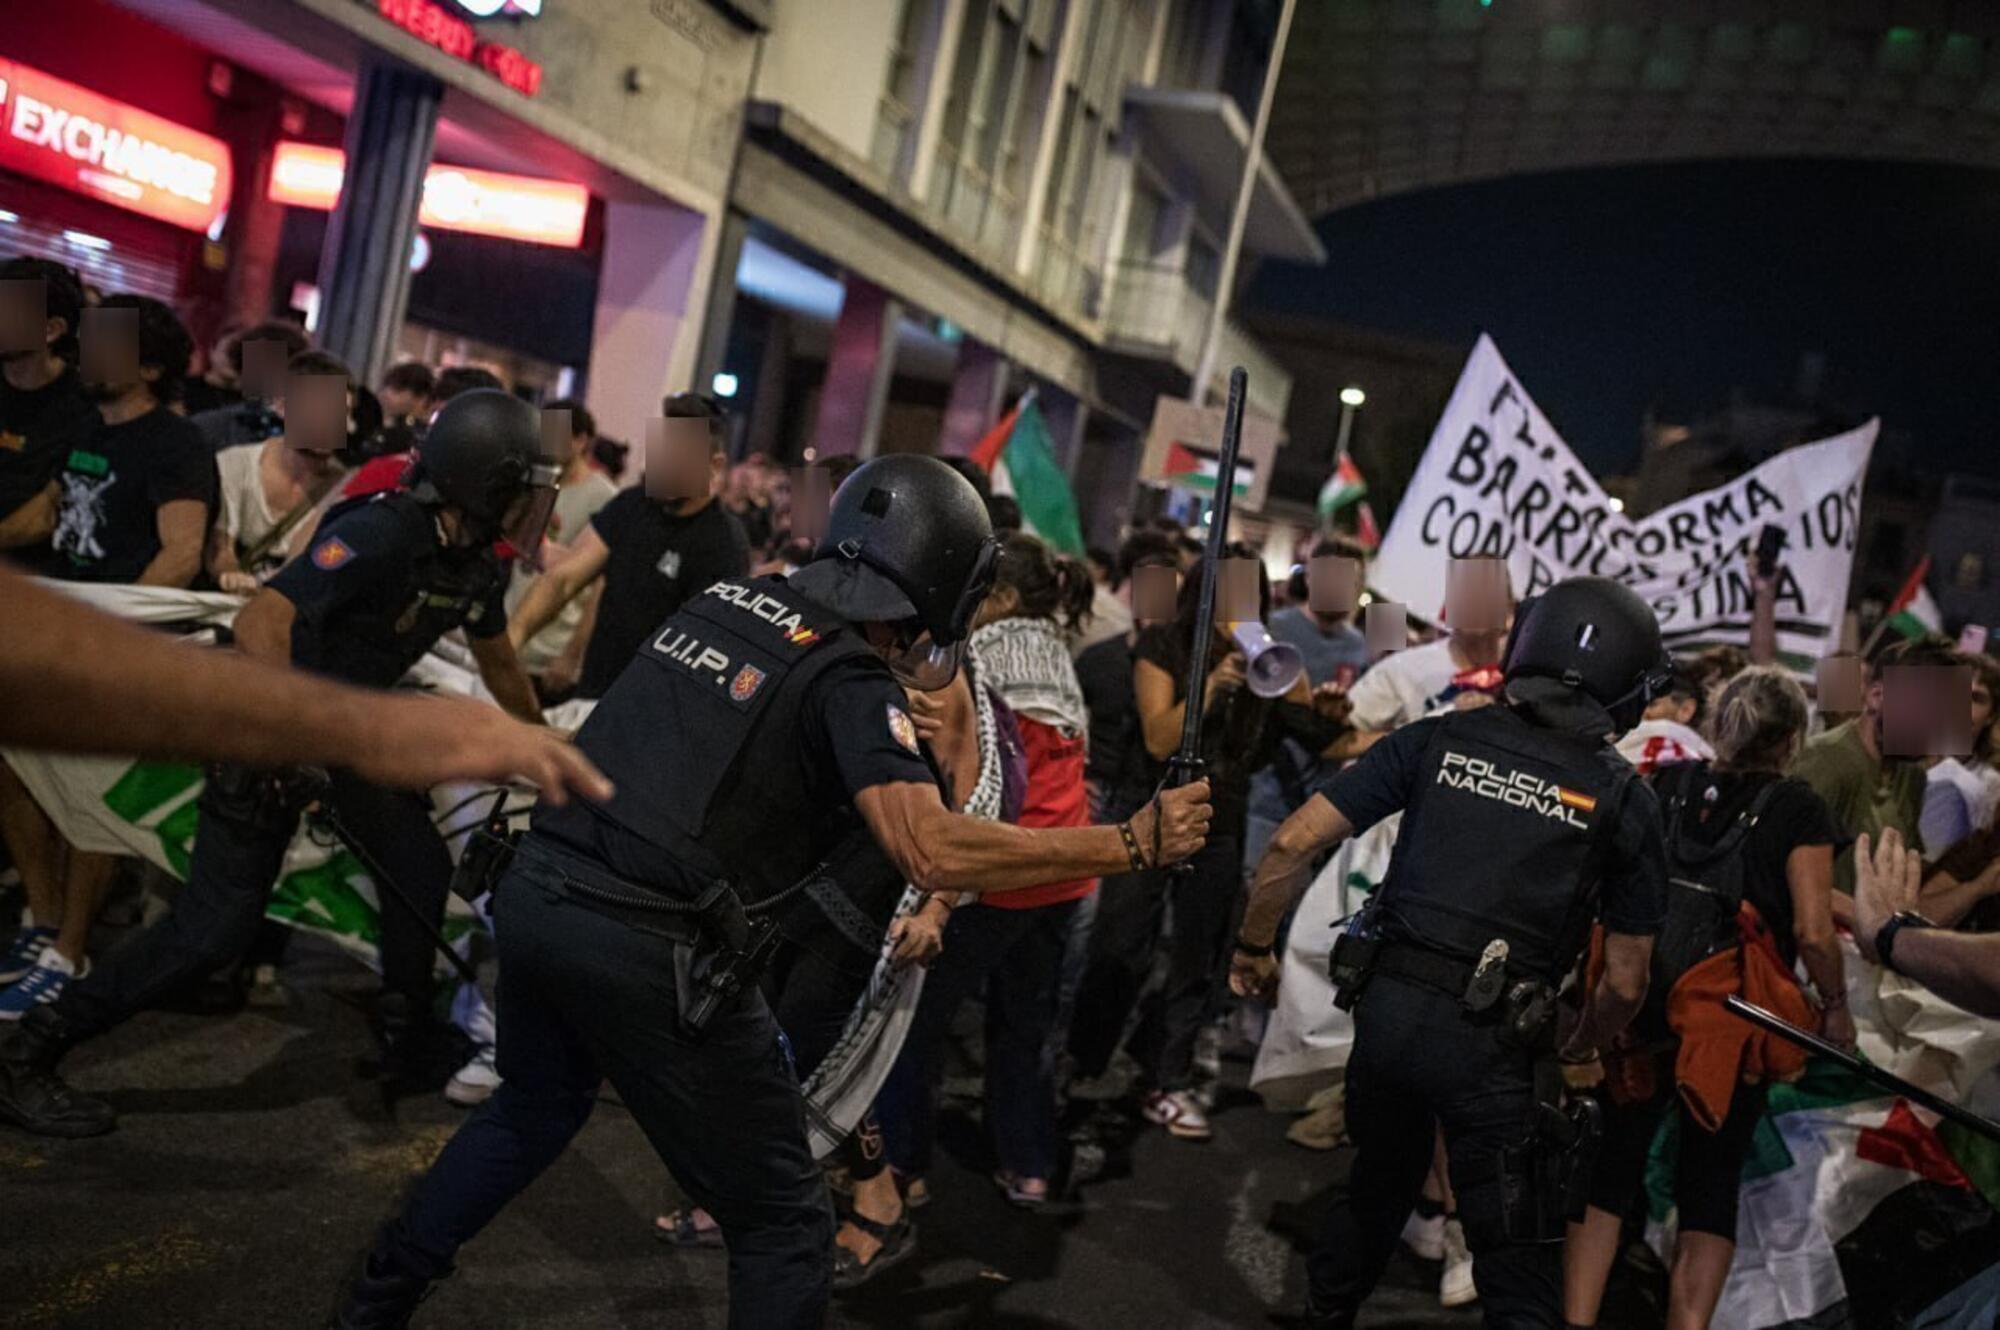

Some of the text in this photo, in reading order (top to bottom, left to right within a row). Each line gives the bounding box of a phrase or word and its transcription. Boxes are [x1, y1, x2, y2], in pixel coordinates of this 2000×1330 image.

[1422, 495, 1517, 559] CON
[704, 581, 802, 635] POLICIA
[653, 627, 730, 685] U.I.P.
[1437, 768, 1589, 830] NACIONAL
[1442, 751, 1562, 803] POLICIA
